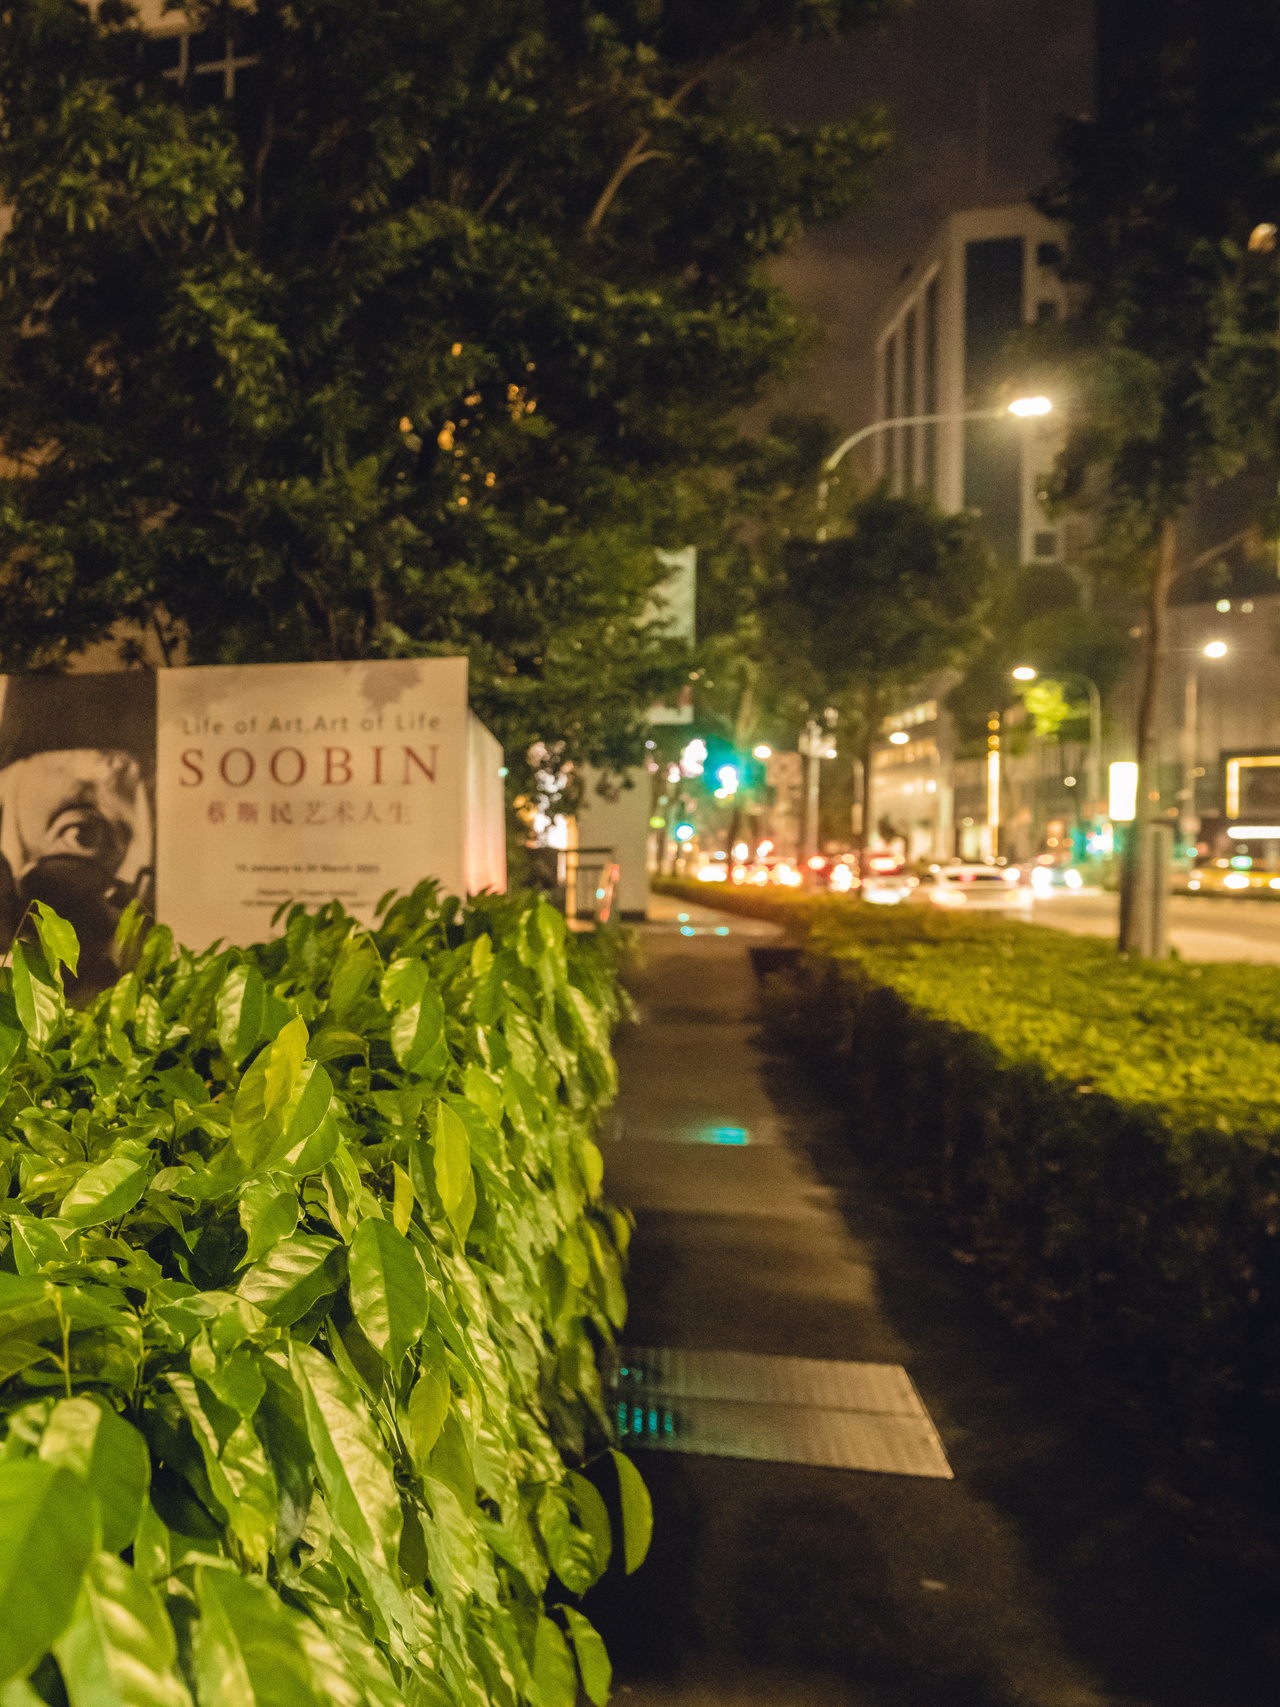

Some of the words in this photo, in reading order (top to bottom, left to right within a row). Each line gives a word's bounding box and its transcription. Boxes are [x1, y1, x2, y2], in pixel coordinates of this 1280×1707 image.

[183, 716, 223, 736] Life
[234, 715, 257, 734] of
[360, 712, 383, 731] of
[394, 711, 441, 732] Life
[179, 745, 438, 788] SOOBIN
